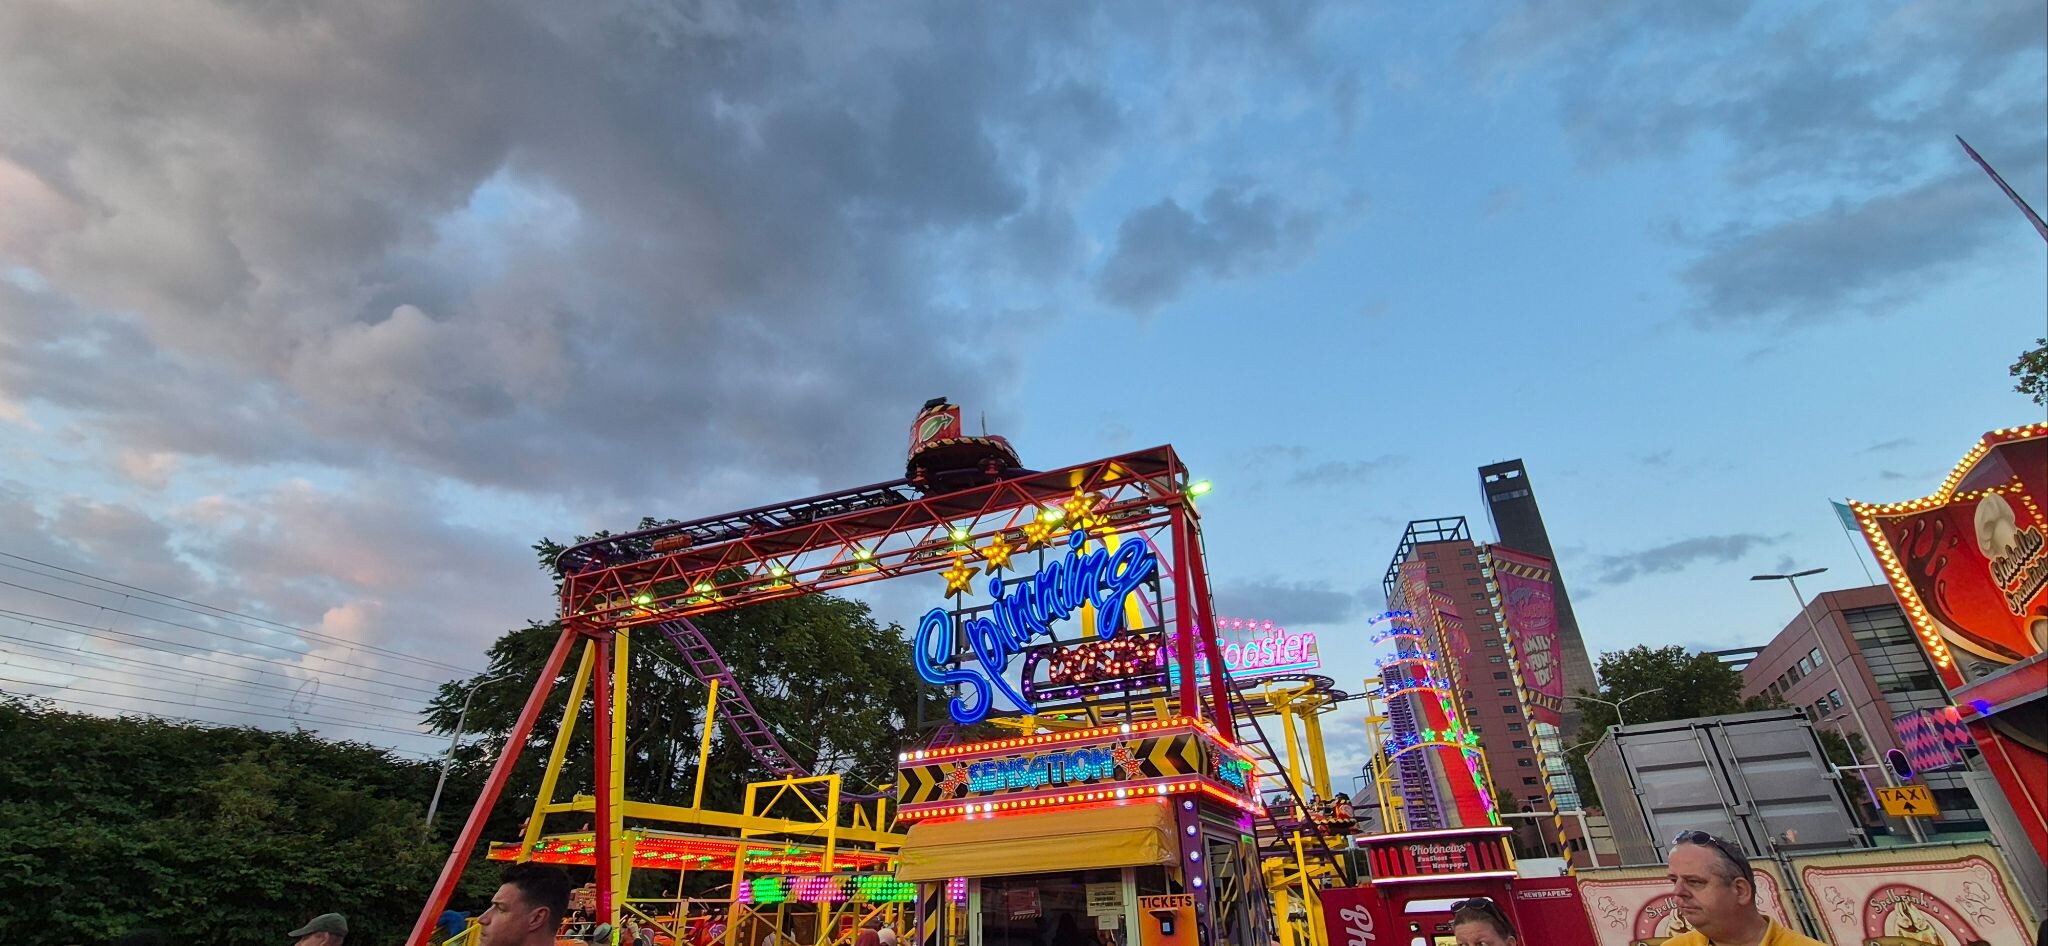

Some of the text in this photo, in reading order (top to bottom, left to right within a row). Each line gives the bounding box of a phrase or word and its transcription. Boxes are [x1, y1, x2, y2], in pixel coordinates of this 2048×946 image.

[914, 529, 1157, 724] Spinning
[967, 746, 1115, 793] SENSATION
[1880, 788, 1928, 802] TAXI
[1409, 843, 1466, 856] Photonews
[1432, 861, 1468, 869] Newspaper
[1523, 889, 1566, 899] NEWSPAPER
[1139, 895, 1193, 909] TICKETS
